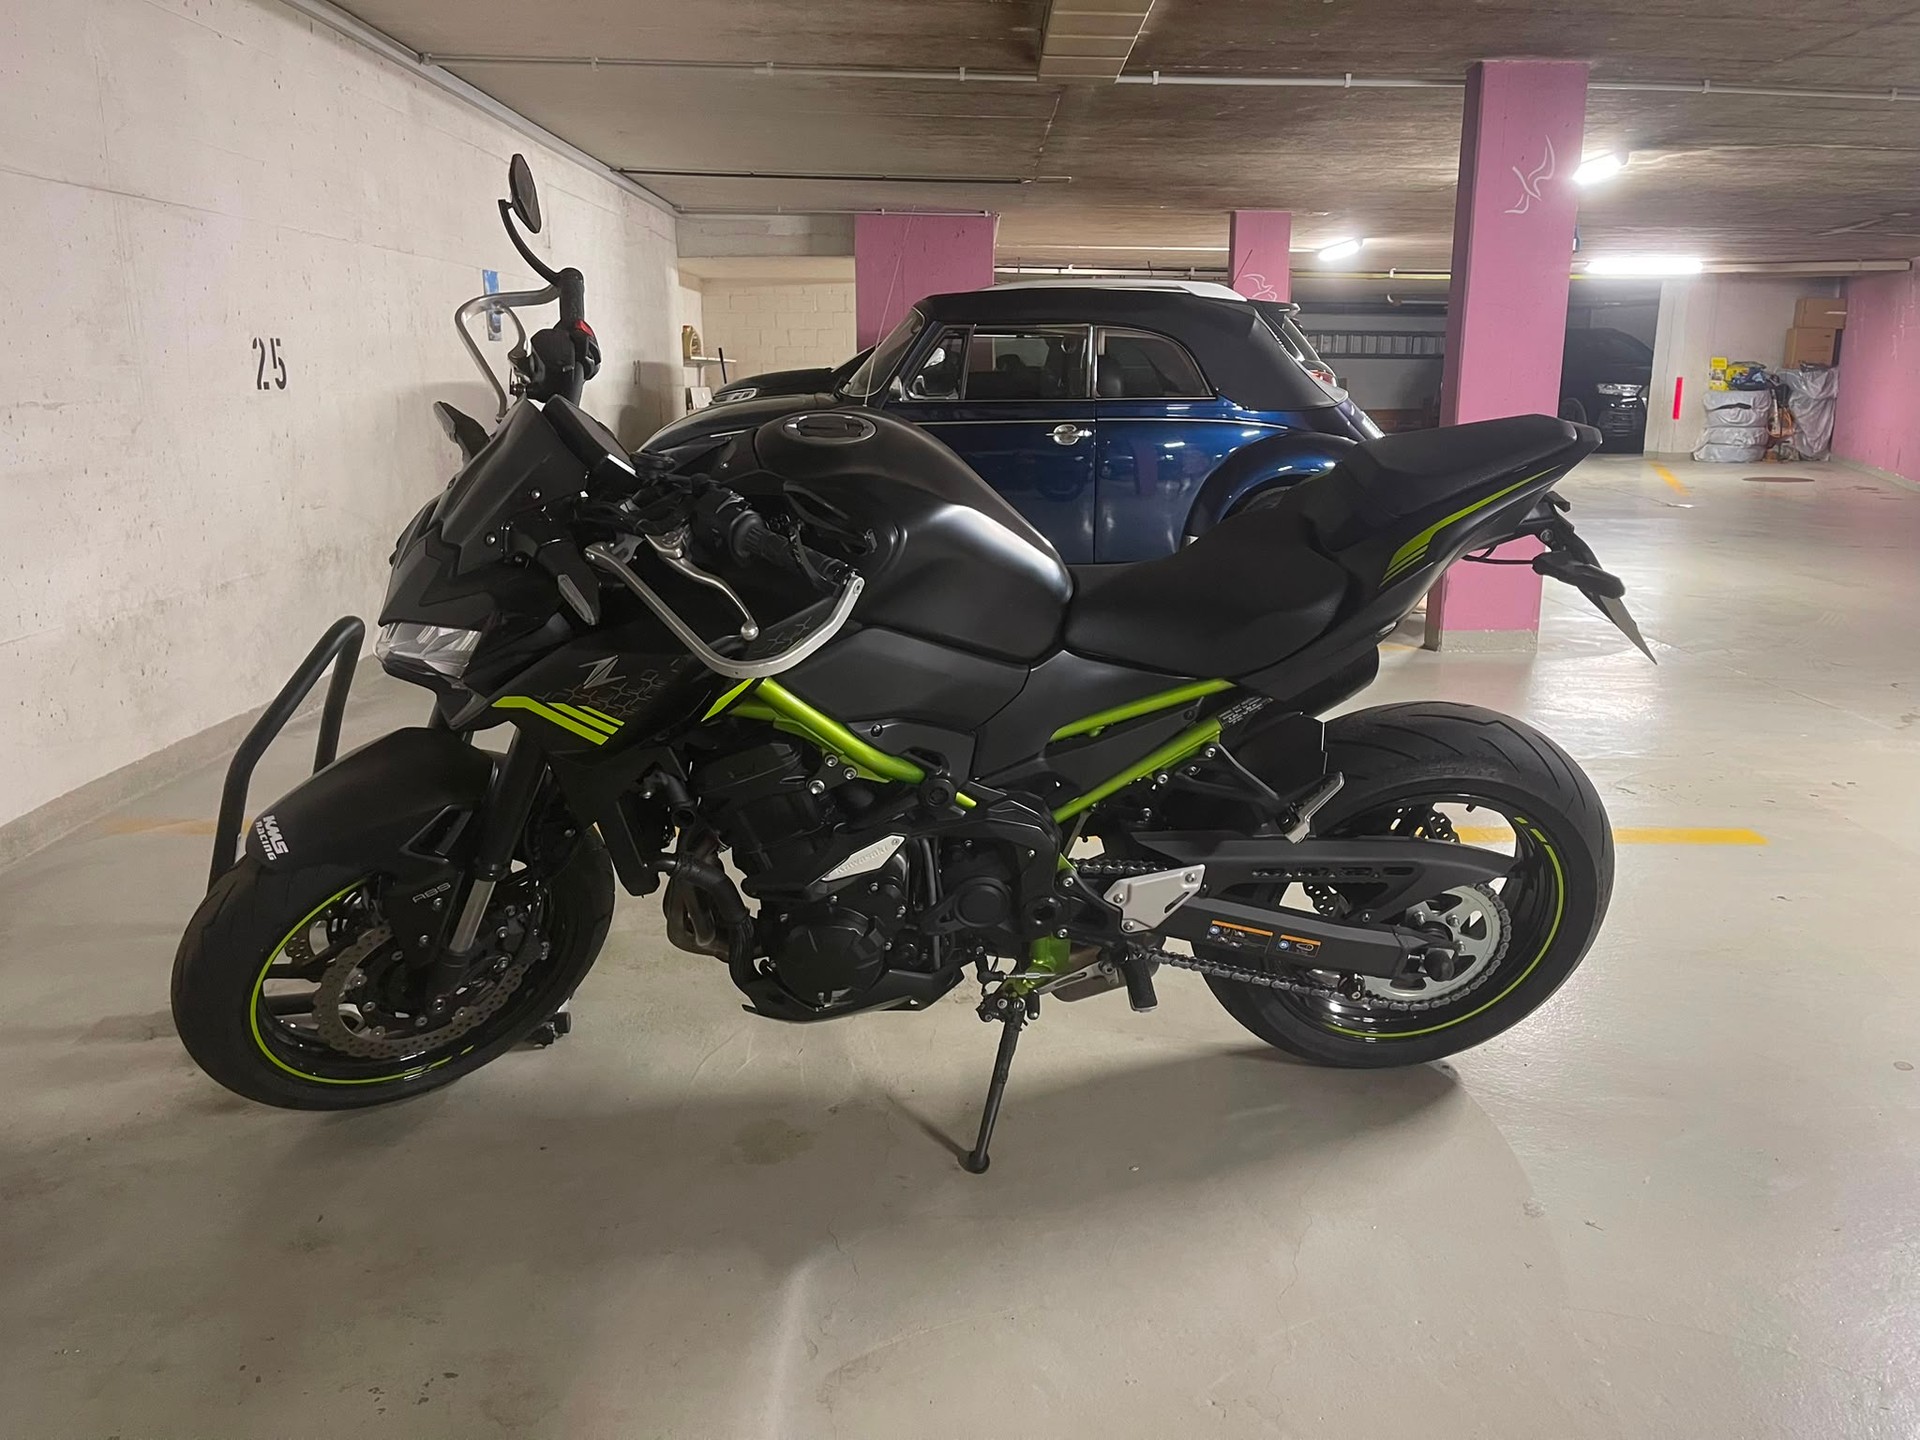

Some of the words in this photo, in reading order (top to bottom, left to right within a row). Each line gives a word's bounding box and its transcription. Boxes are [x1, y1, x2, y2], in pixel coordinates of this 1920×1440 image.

[252, 337, 287, 390] 25
[262, 815, 289, 855] KMS
[412, 882, 451, 903] ABS
